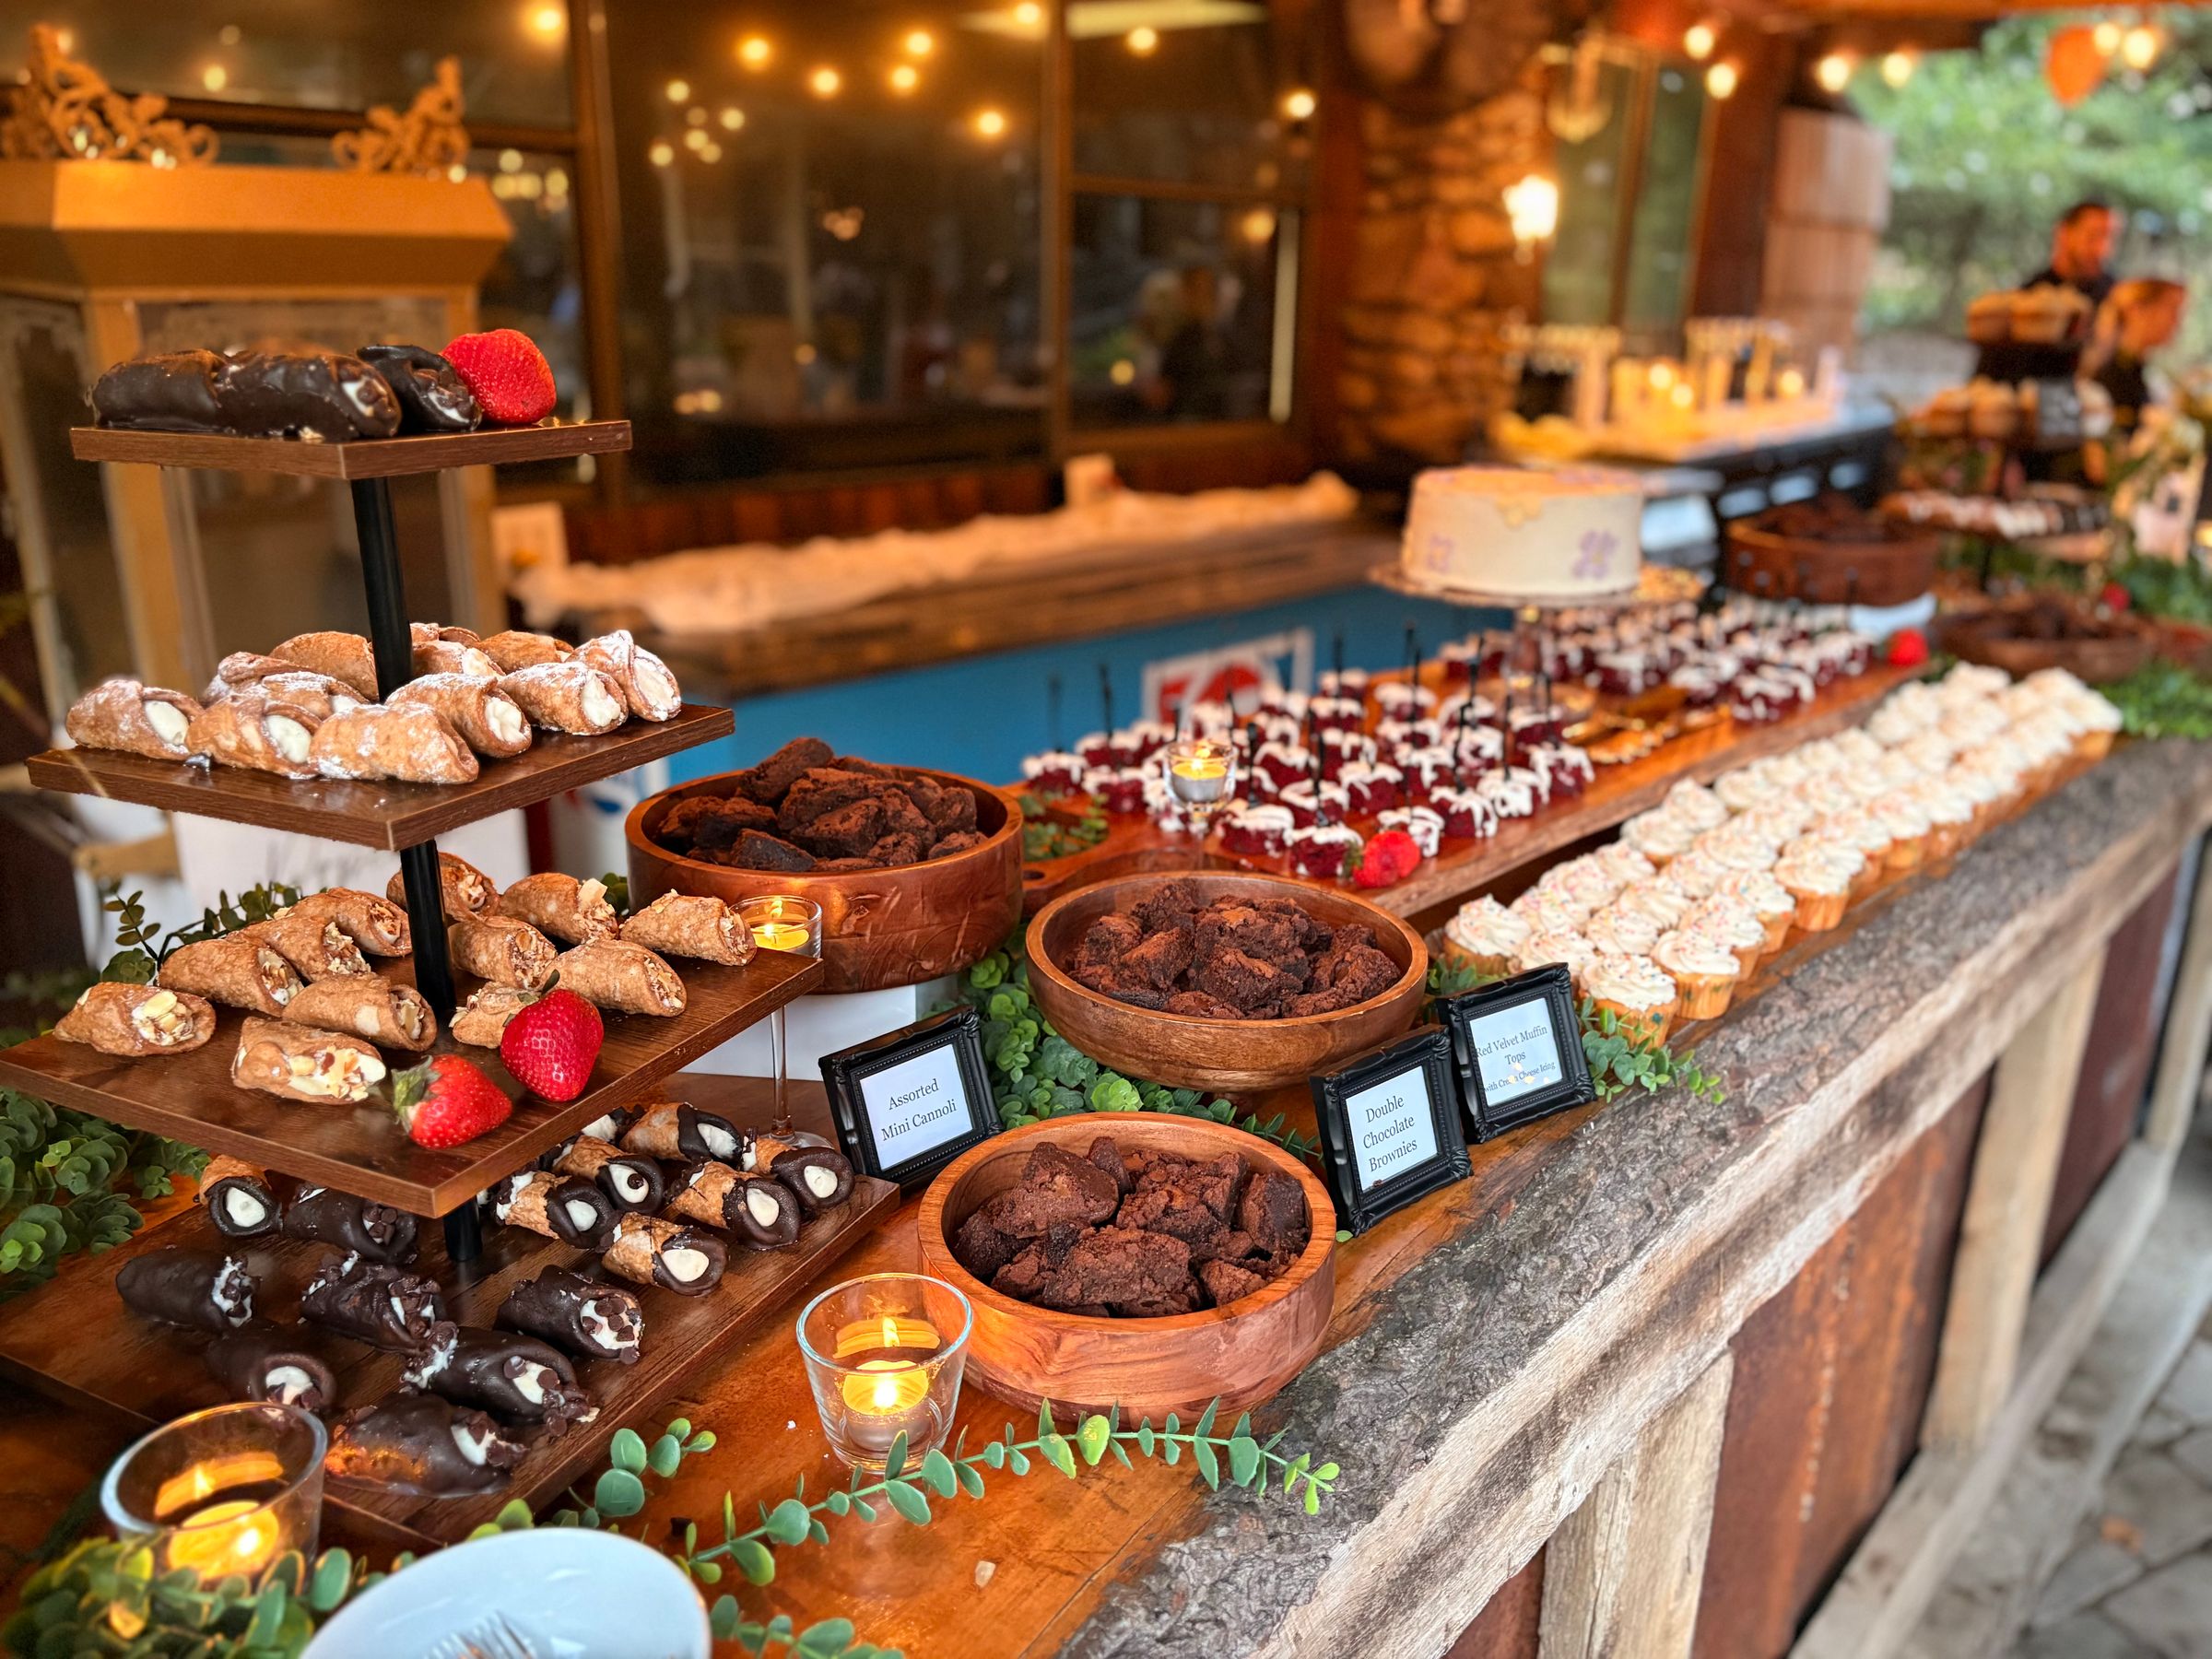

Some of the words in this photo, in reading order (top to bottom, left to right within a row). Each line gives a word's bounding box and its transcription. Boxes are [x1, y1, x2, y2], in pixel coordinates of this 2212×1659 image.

[1476, 1043, 1492, 1057] Red
[1492, 1035, 1519, 1051] Velvet
[1520, 1026, 1548, 1042] Muffin
[1504, 1052, 1526, 1065] Tops
[1540, 1062, 1557, 1073] Icing
[888, 1078, 939, 1111] Assorted
[1365, 1095, 1405, 1123] Double
[881, 1118, 911, 1141] Mini
[912, 1099, 958, 1127] Cannoli
[1363, 1116, 1416, 1148] Chocolate
[1369, 1139, 1418, 1172] Brownies
